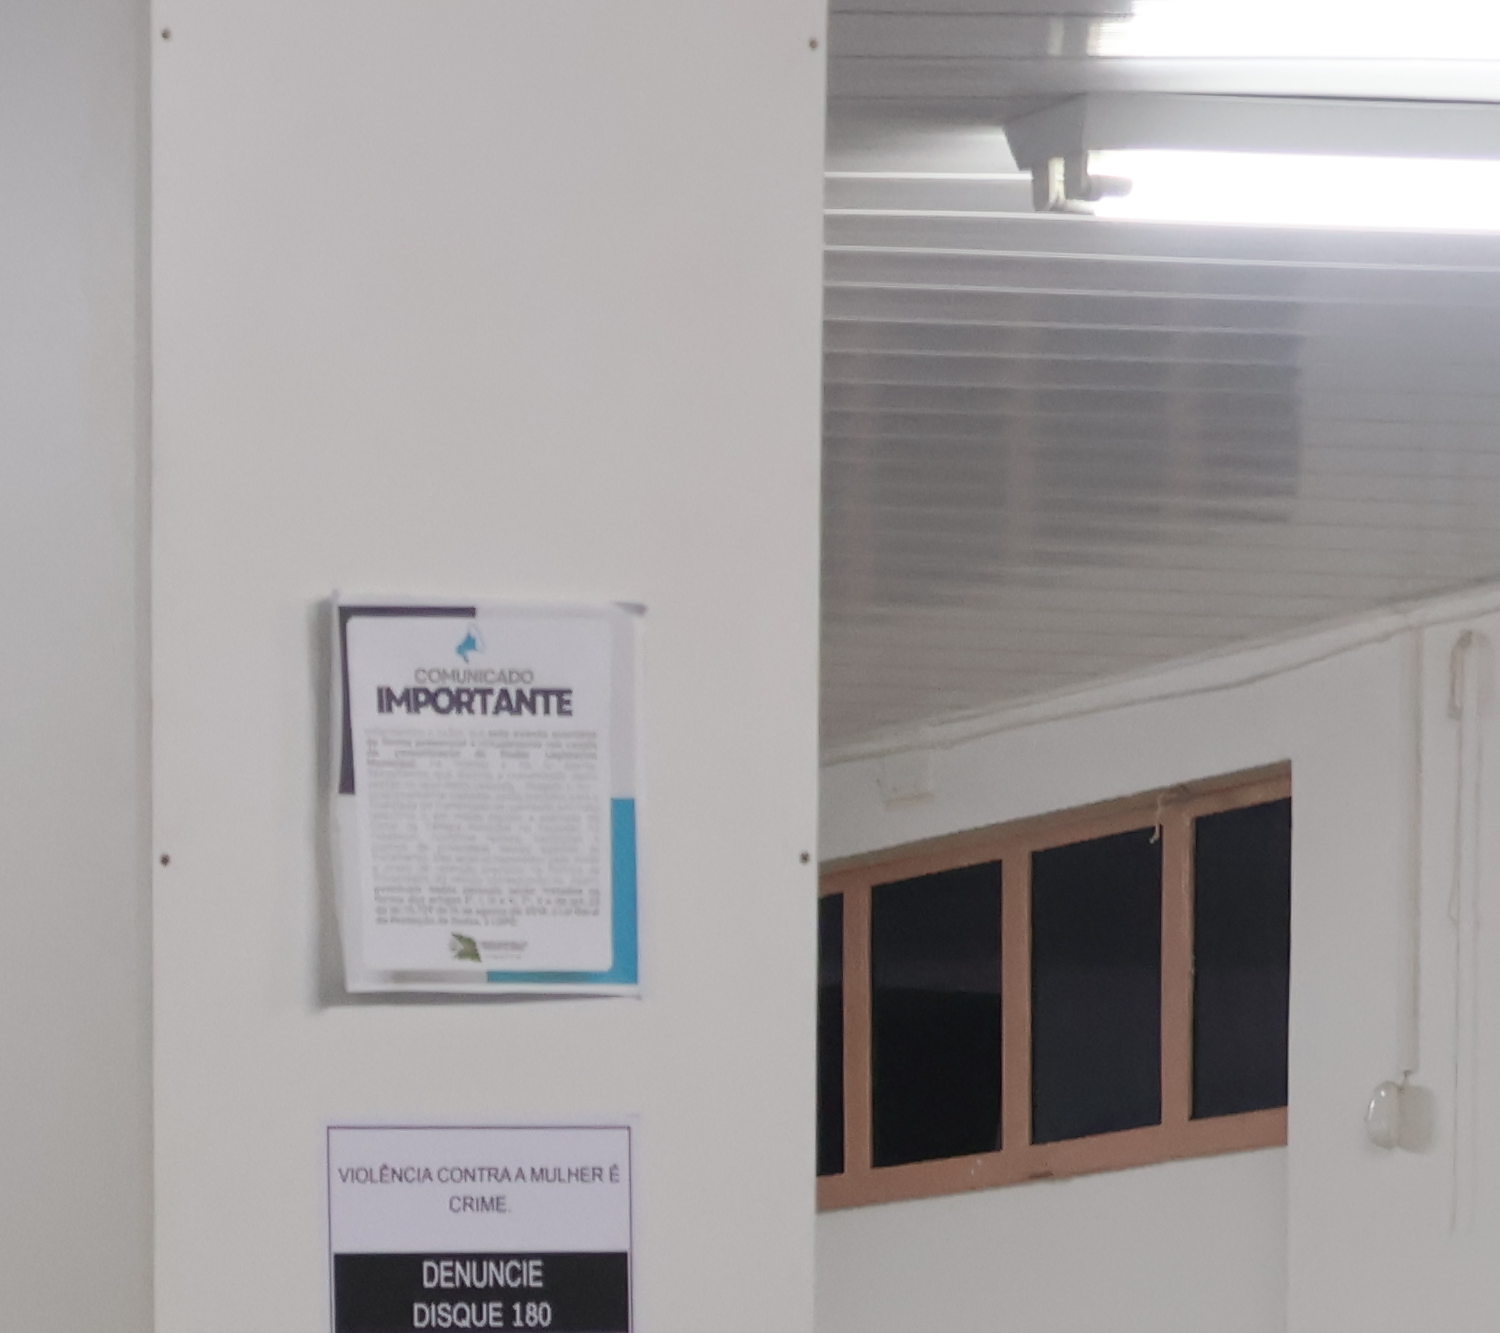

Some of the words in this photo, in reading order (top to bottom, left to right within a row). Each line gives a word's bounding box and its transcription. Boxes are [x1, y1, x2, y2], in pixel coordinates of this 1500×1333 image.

[414, 669, 534, 684] COMUNICADO
[377, 688, 573, 716] IMPORTANTE
[338, 1163, 433, 1183] VIOLÊNCIA
[437, 1167, 511, 1183] CONTRA
[514, 1167, 525, 1182] A
[531, 1167, 604, 1183] MULHER
[609, 1164, 620, 1182] É
[449, 1196, 512, 1213] CRIME.
[422, 1259, 543, 1288] DENUNCIE
[413, 1302, 503, 1328] DISQUE
[513, 1301, 552, 1327] 180
